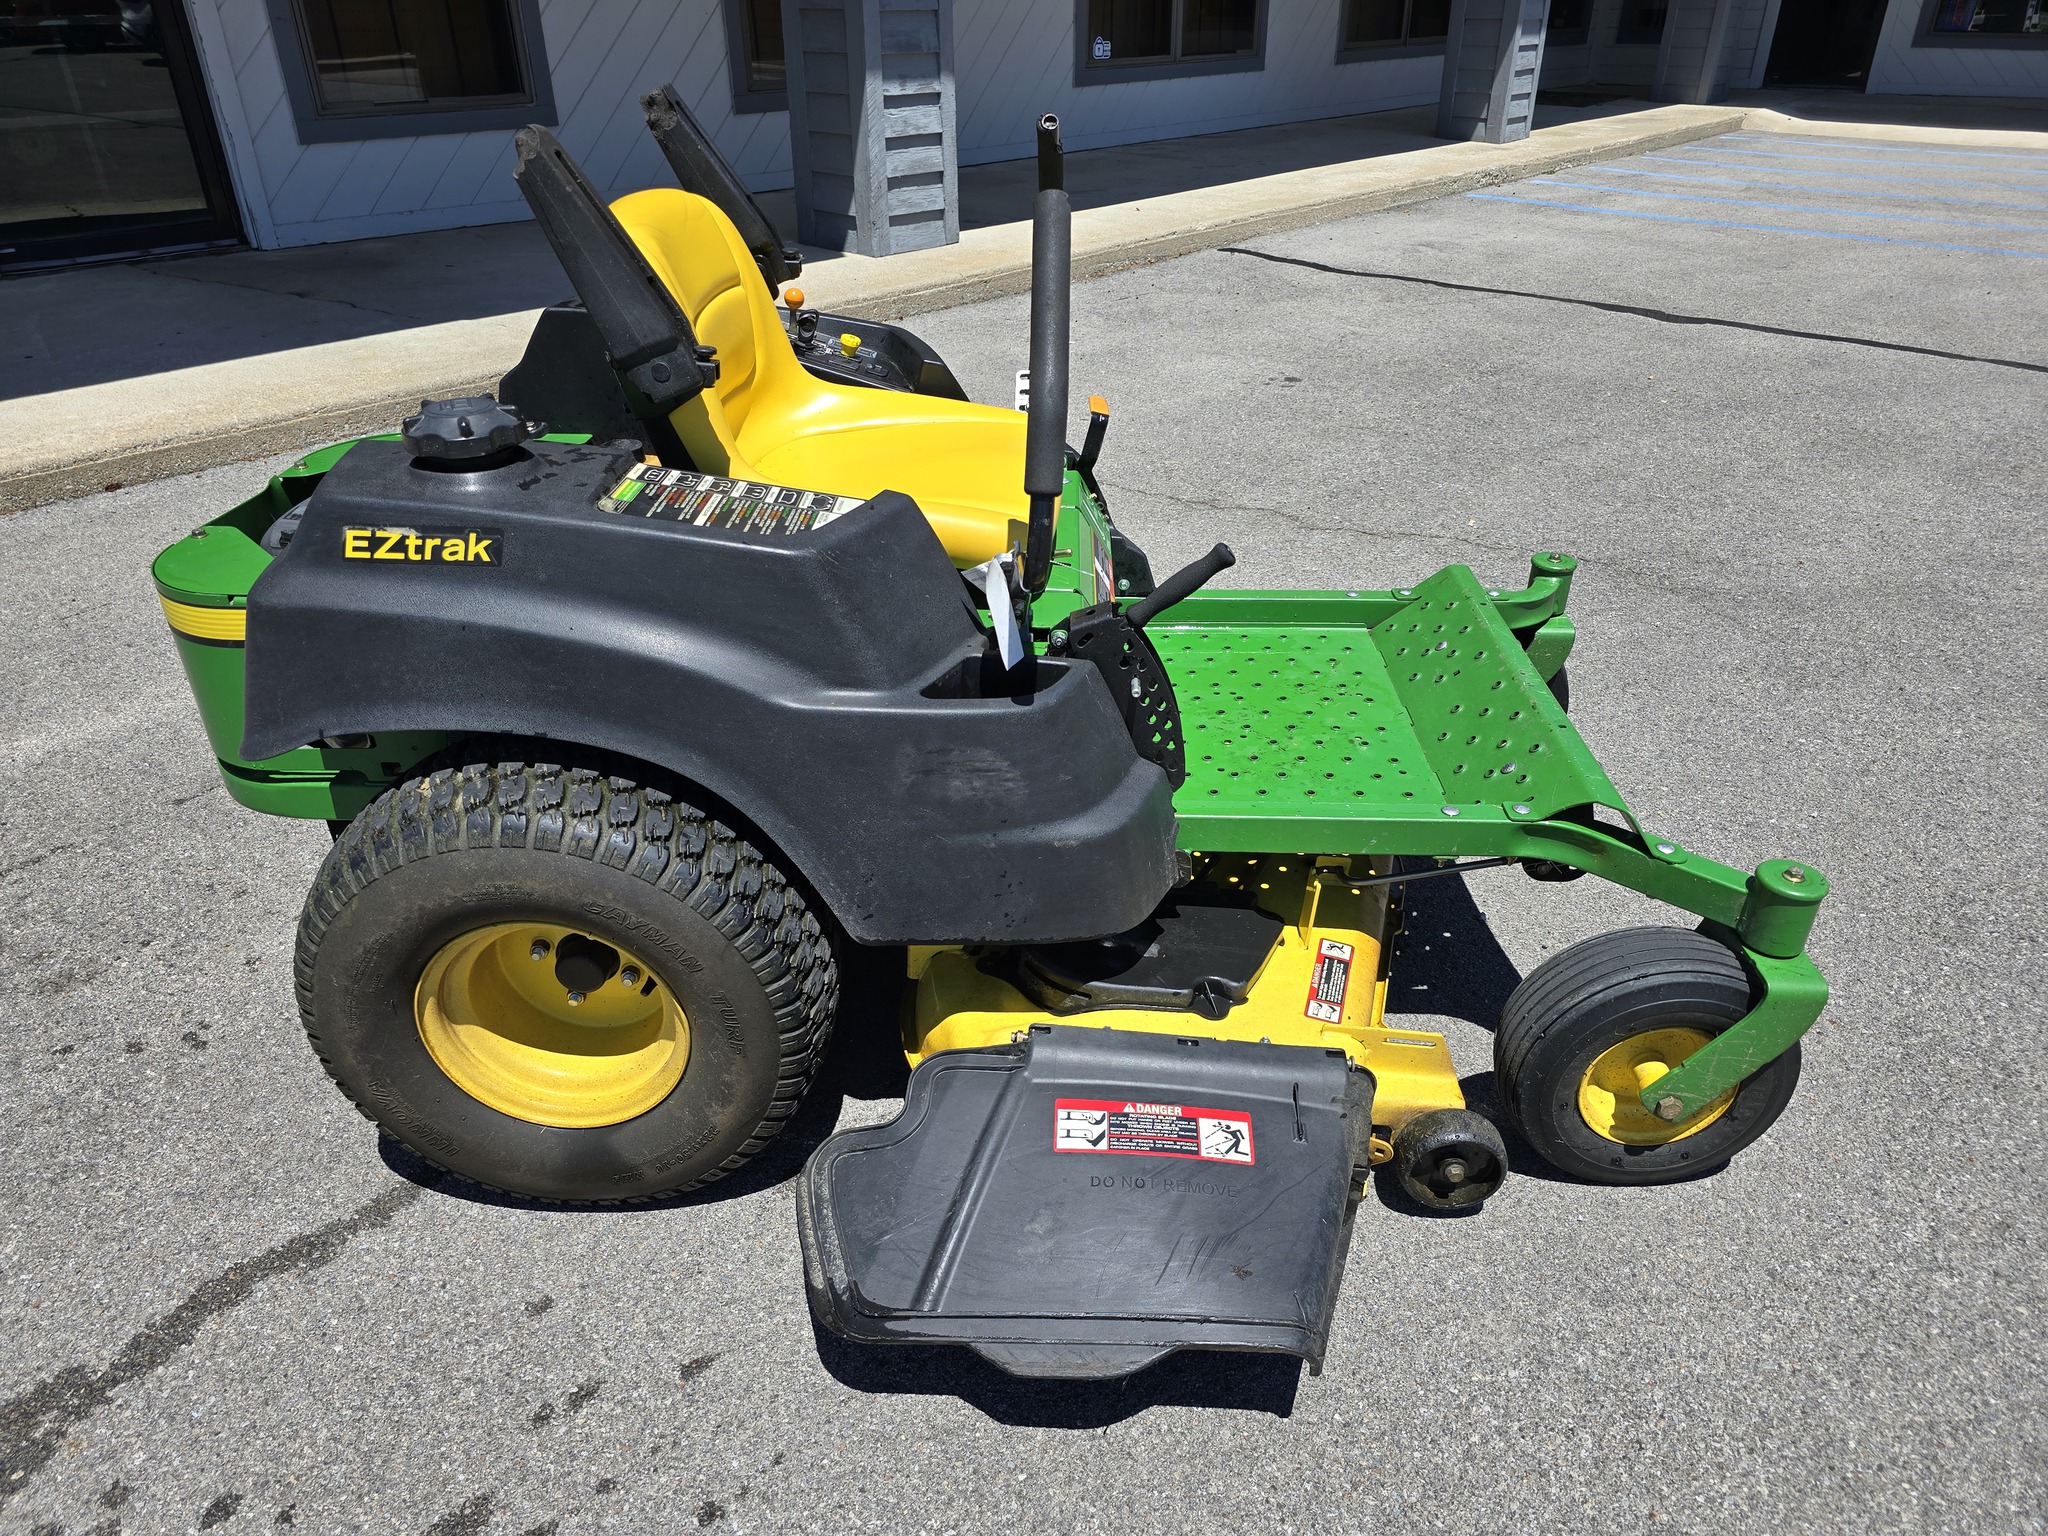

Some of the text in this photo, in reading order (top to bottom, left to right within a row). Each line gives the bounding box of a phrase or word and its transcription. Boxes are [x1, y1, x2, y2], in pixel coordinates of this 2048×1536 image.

[345, 530, 492, 562] EZtrak
[1311, 963, 1322, 984] DANGER
[710, 990, 745, 1055] TURF
[1136, 1103, 1182, 1116] DANGER
[1090, 1175, 1239, 1198] DO NOT REMOVE
